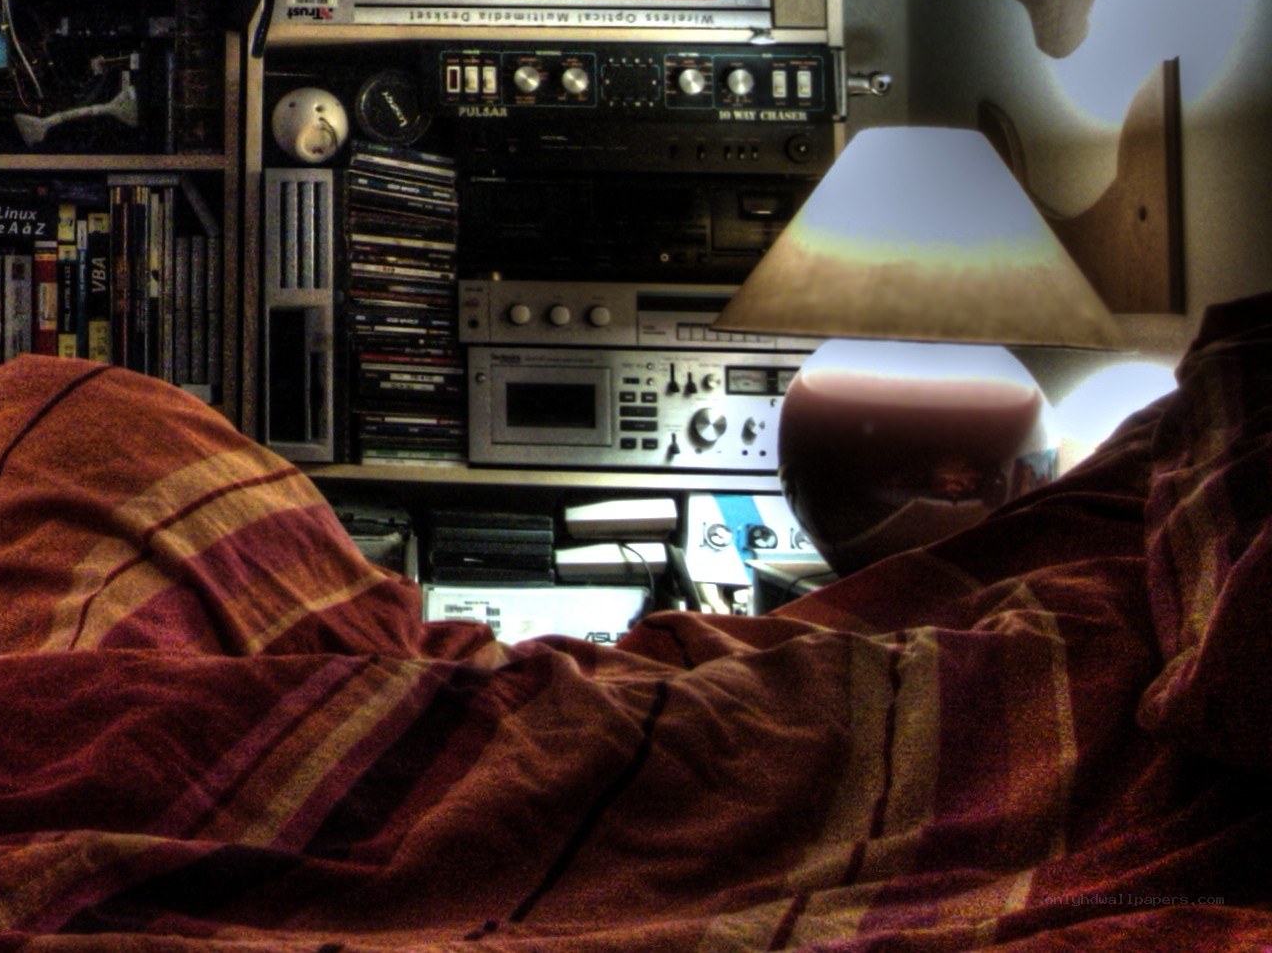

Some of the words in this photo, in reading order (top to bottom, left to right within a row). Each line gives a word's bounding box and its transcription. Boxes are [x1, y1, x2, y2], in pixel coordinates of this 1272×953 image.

[286, 6, 323, 20] Trust
[409, 11, 470, 22] Deskset
[479, 11, 570, 23] Multimedia
[578, 12, 637, 24] Optical
[645, 13, 715, 24] Wireless
[458, 105, 508, 118] PULSAR
[731, 110, 756, 121] WAY
[759, 110, 808, 122] CHASER
[7, 220, 19, 235] A
[21, 221, 32, 236] à
[34, 222, 47, 236] Z
[91, 256, 107, 294] VBA
